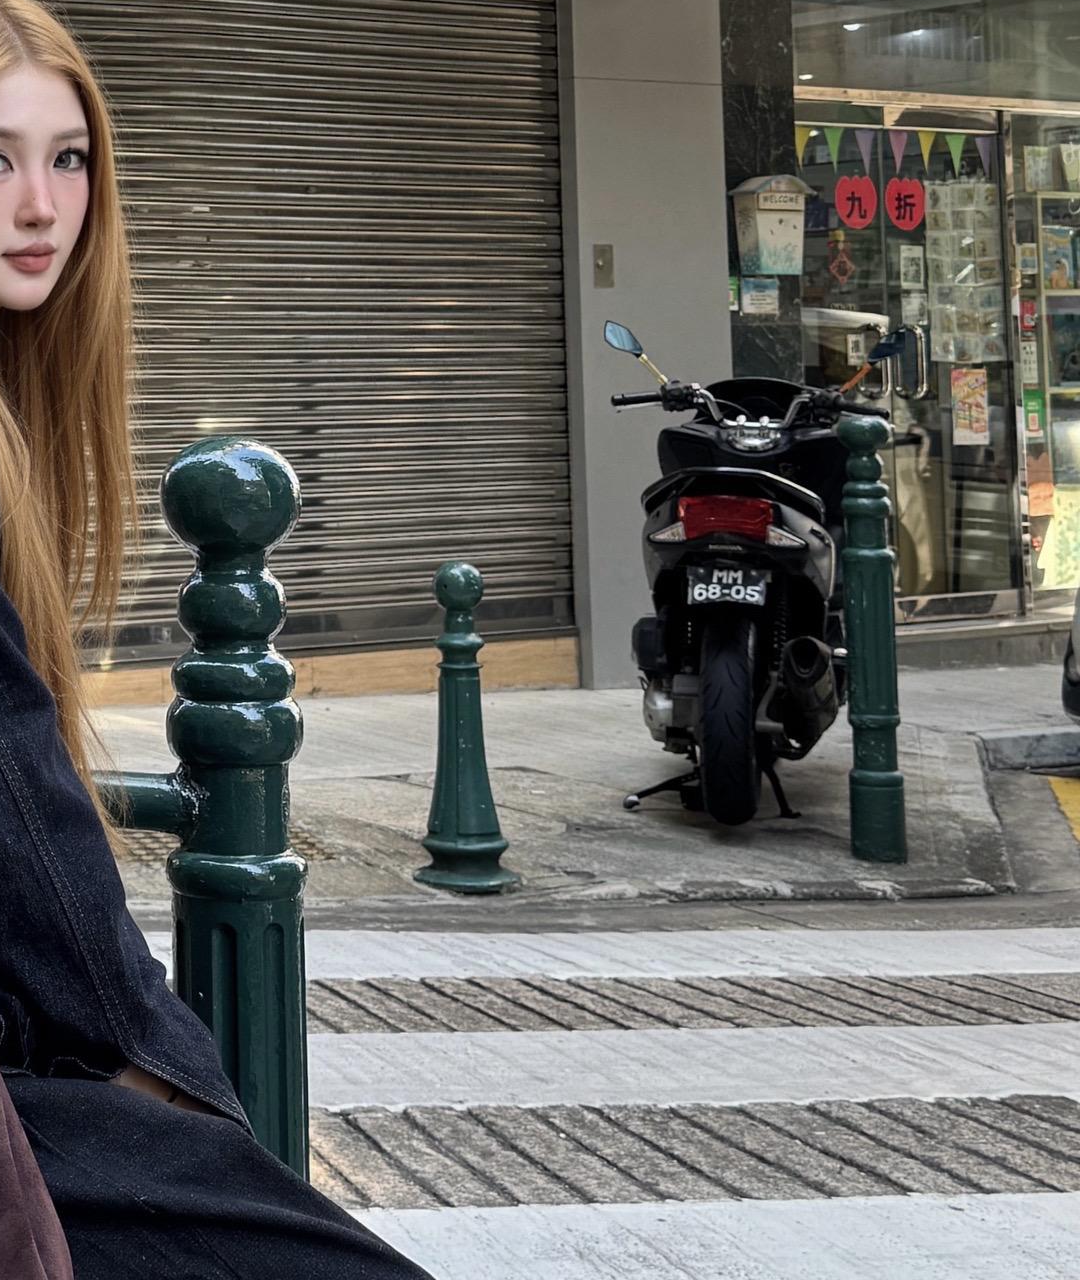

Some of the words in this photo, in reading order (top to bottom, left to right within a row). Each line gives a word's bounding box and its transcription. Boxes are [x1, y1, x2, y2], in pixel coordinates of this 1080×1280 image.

[762, 194, 800, 204] WELCOME
[712, 569, 743, 584] MM
[693, 583, 762, 602] 68-05
